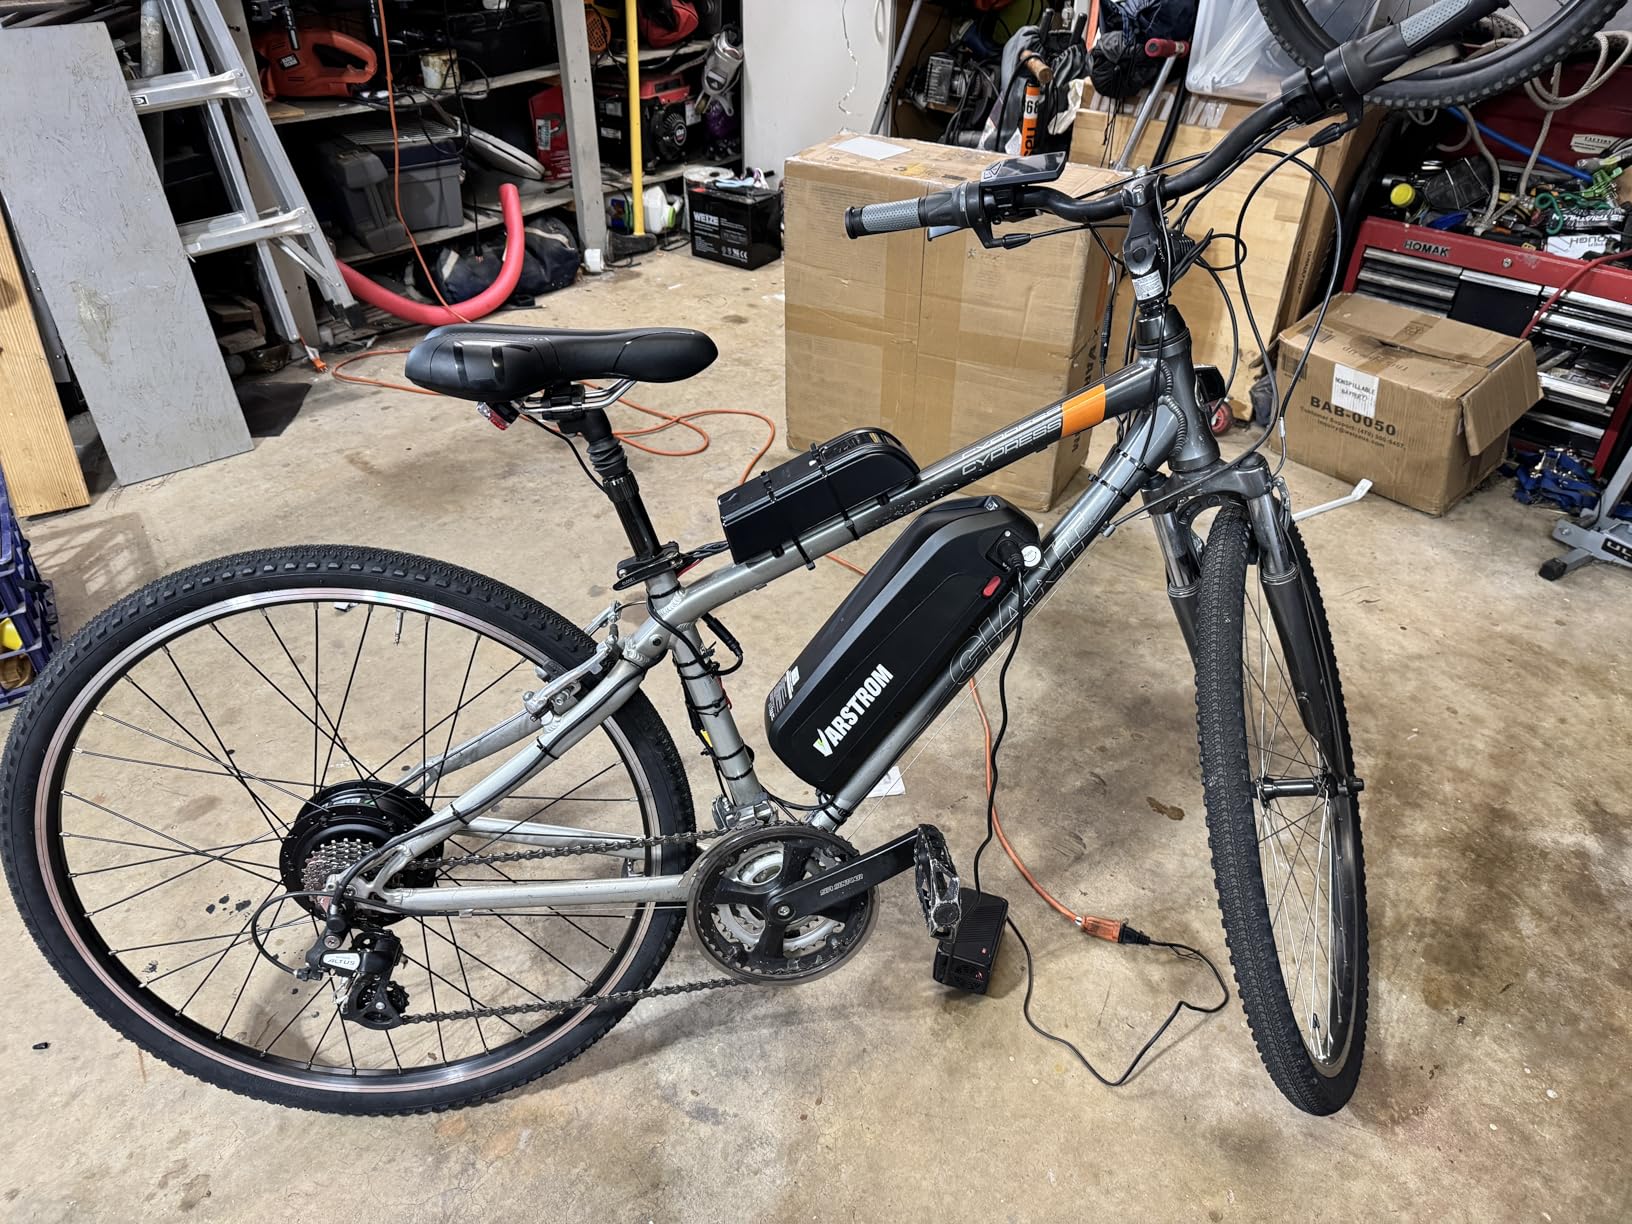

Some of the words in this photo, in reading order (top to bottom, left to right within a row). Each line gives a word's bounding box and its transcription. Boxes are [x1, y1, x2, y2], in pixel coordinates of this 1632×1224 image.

[693, 211, 719, 226] WEIZE
[1403, 240, 1450, 257] HOMAK
[1310, 396, 1397, 437] BAB-0050
[961, 418, 1062, 476] CYPRESS
[812, 663, 894, 757] VARSTROM
